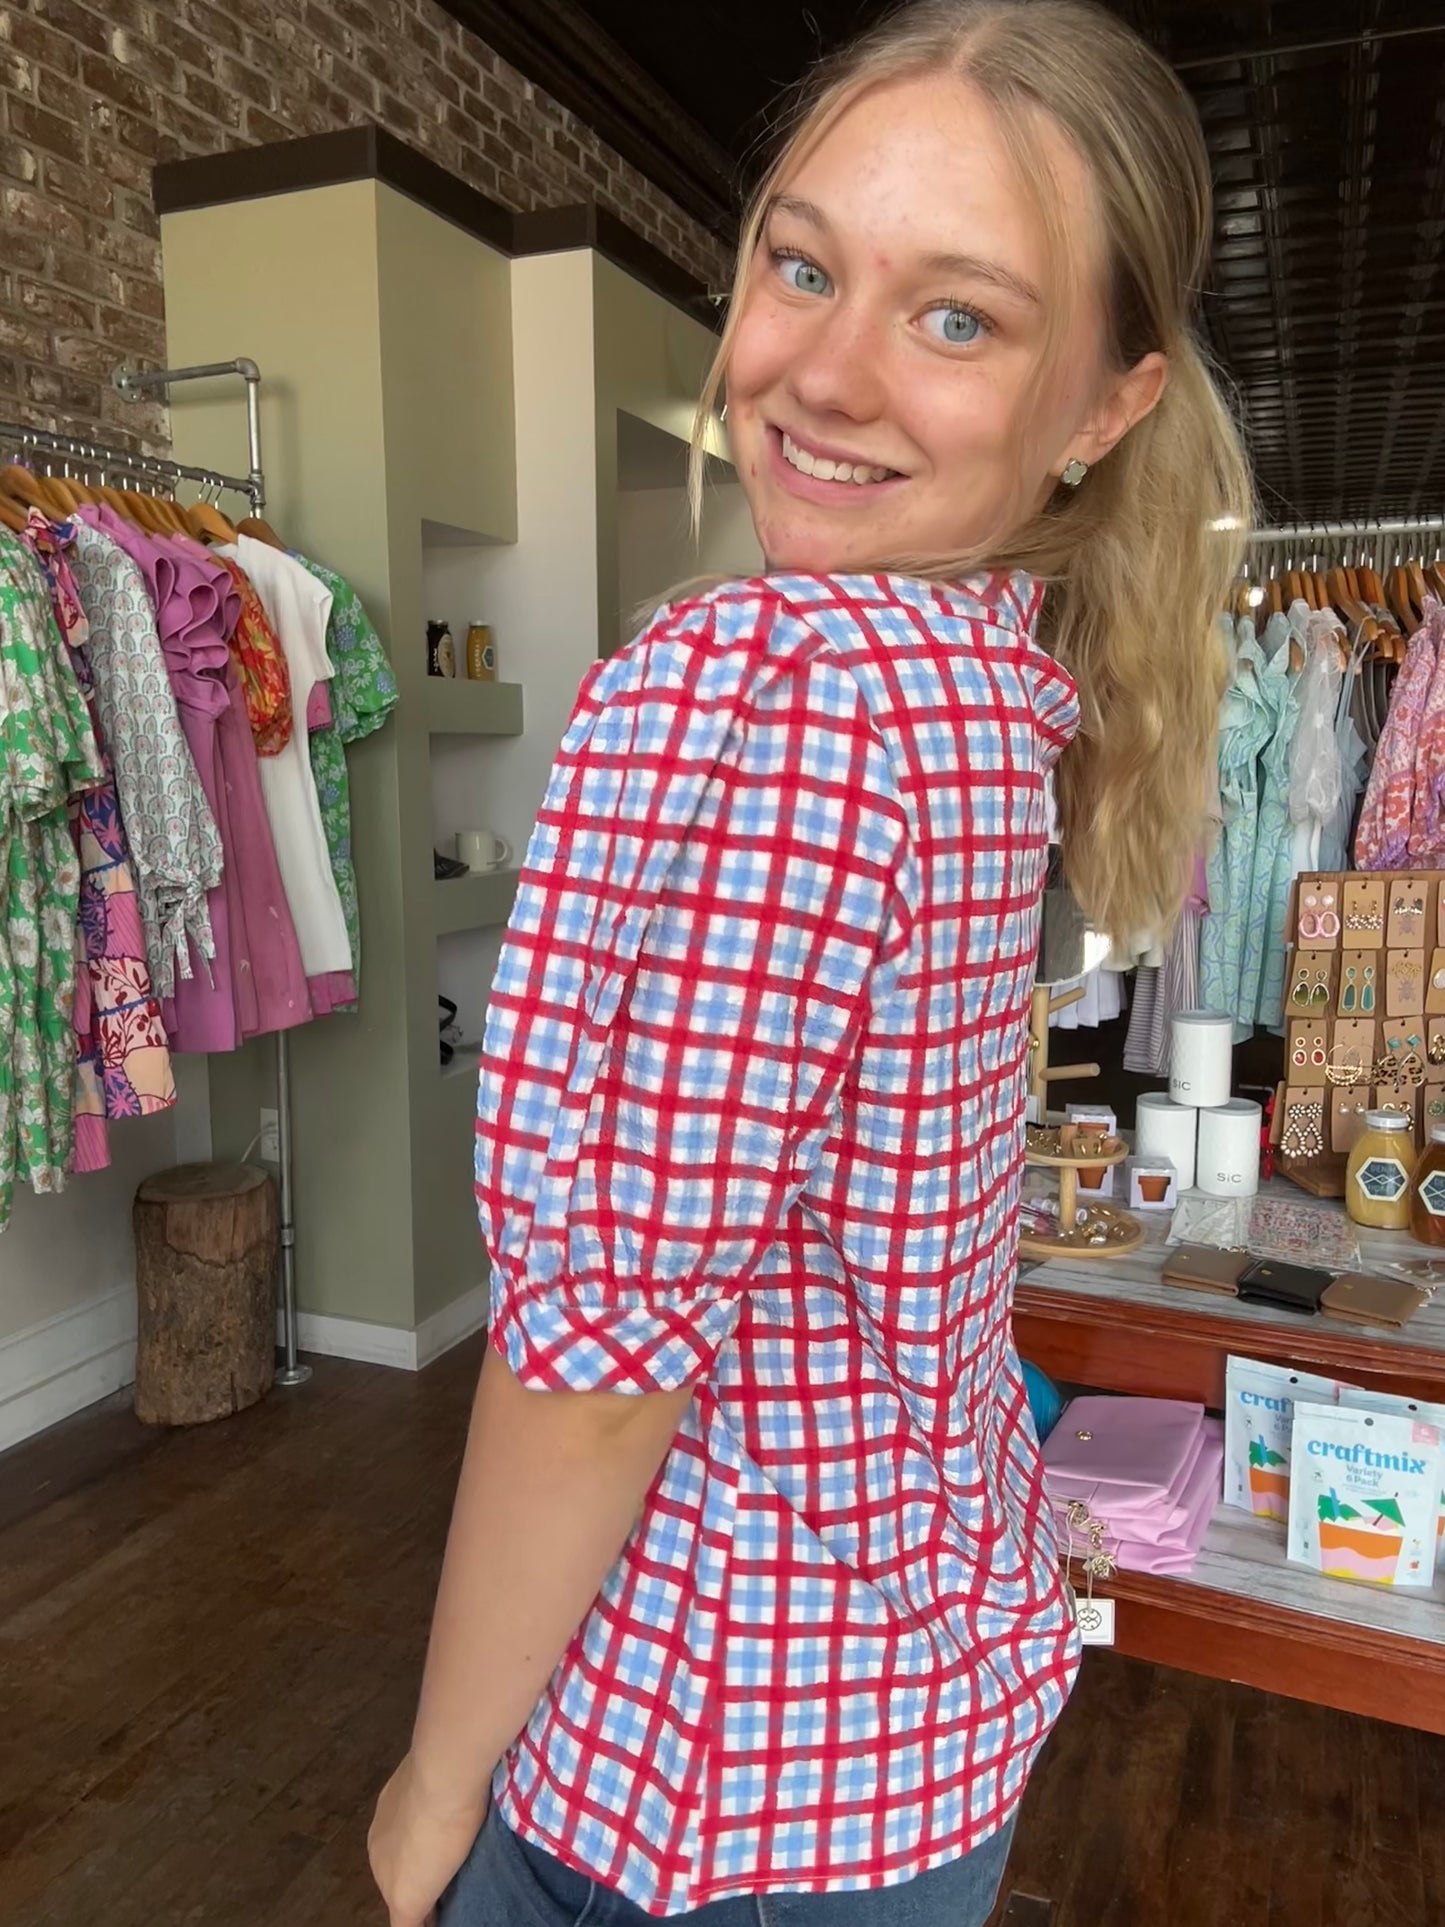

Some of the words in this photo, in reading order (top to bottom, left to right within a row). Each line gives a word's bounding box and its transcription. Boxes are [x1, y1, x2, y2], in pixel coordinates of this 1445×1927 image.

[1240, 1391, 1293, 1413] craf
[1307, 1439, 1427, 1475] craftmix
[1346, 1463, 1384, 1481] Variety
[1346, 1474, 1354, 1482] 6
[1355, 1475, 1379, 1488] Pack
